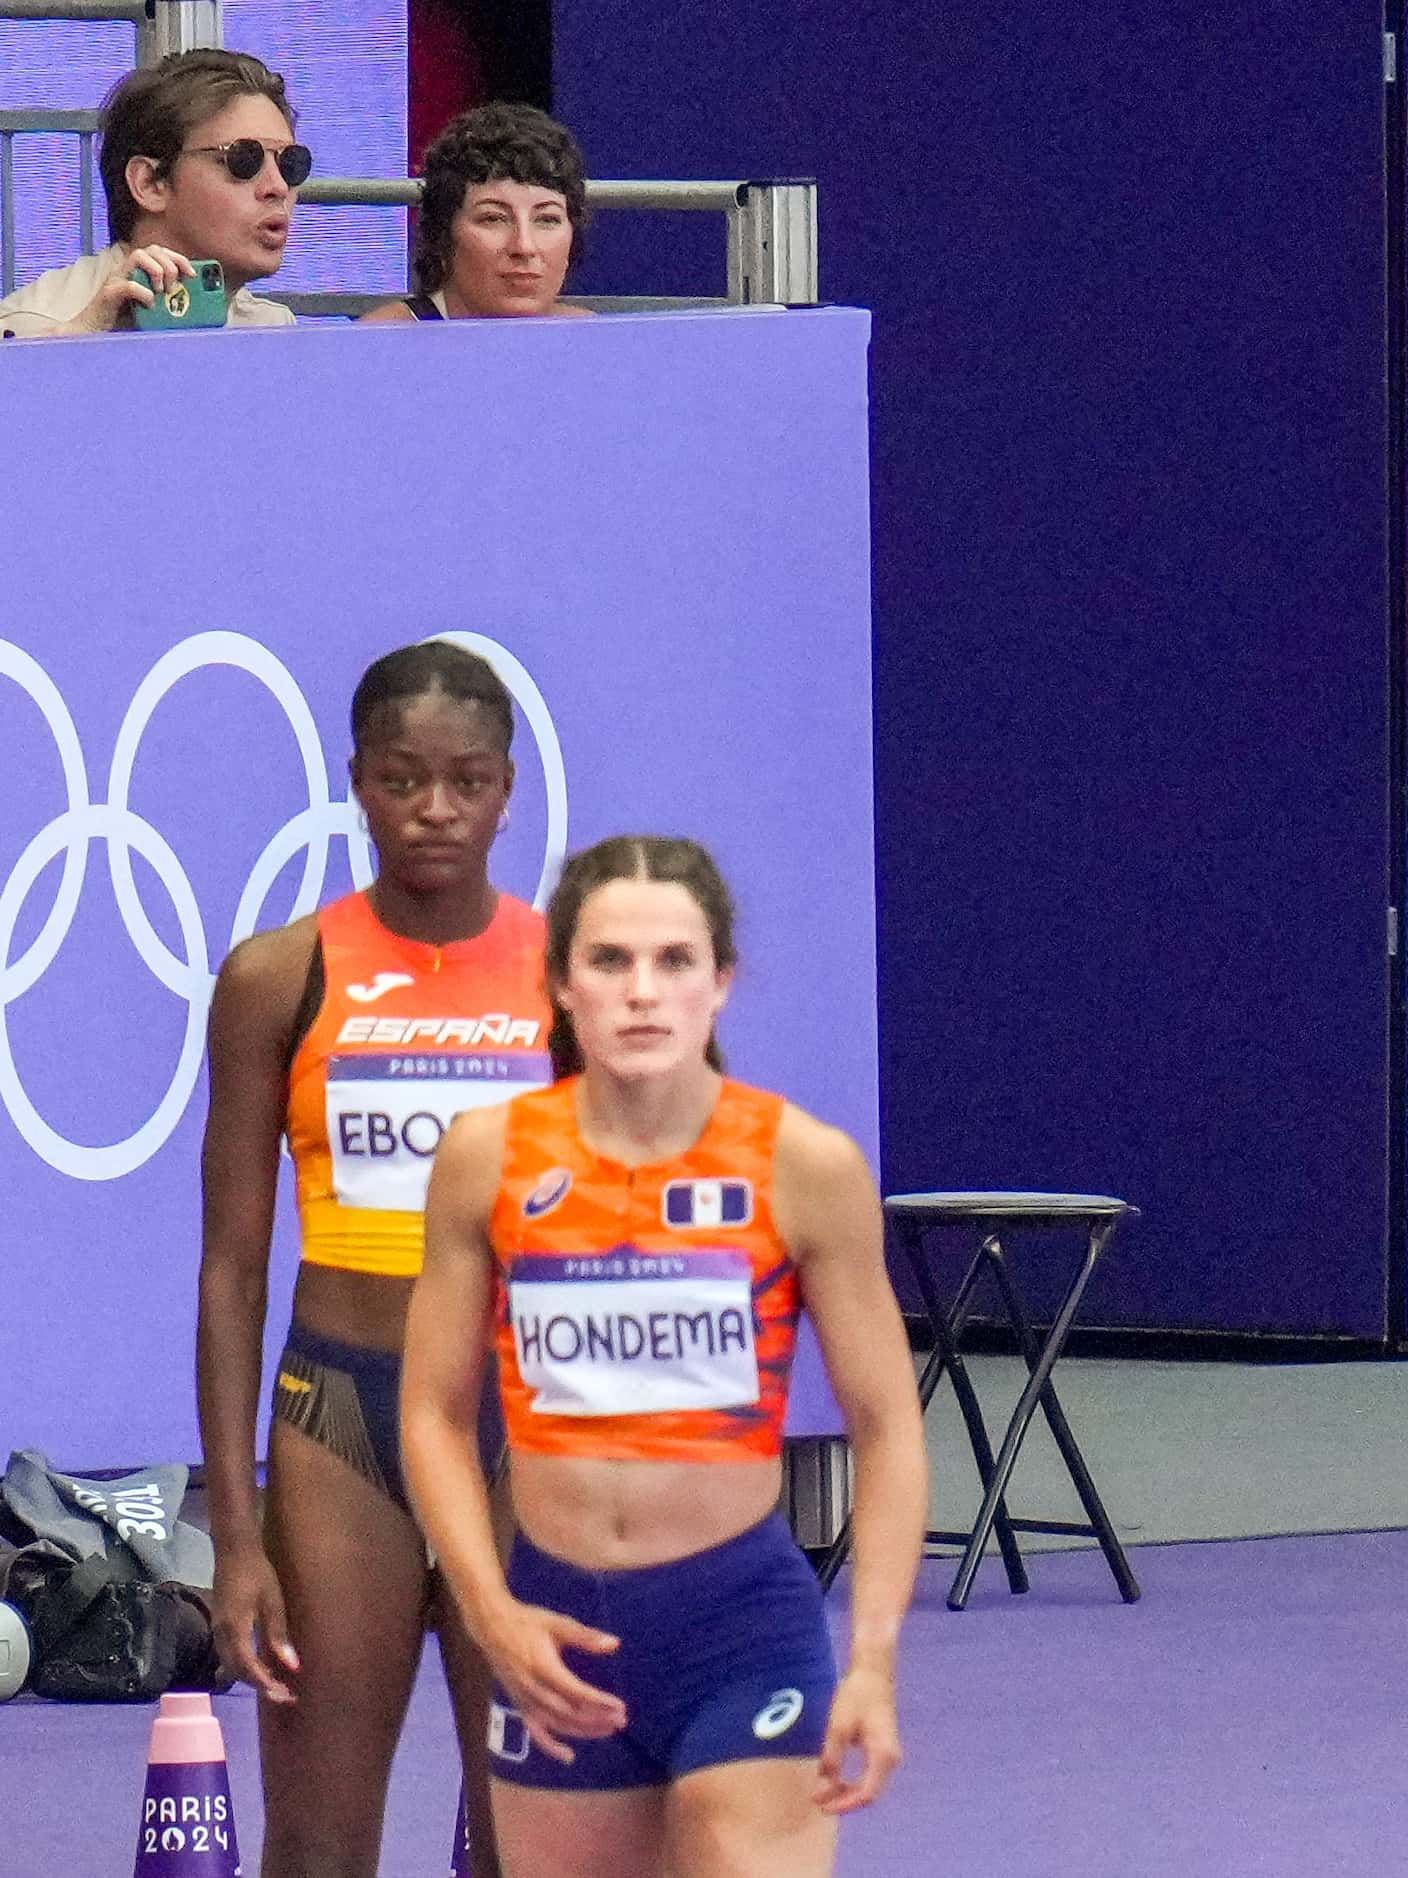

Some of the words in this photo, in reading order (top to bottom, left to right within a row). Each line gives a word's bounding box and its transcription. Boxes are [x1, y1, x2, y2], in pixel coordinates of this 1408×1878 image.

[336, 1012, 541, 1047] ESPAÑA
[337, 1110, 457, 1158] EBO
[518, 1307, 747, 1363] HONDEMA
[144, 1794, 228, 1824] PARIS
[144, 1824, 229, 1853] 2024
